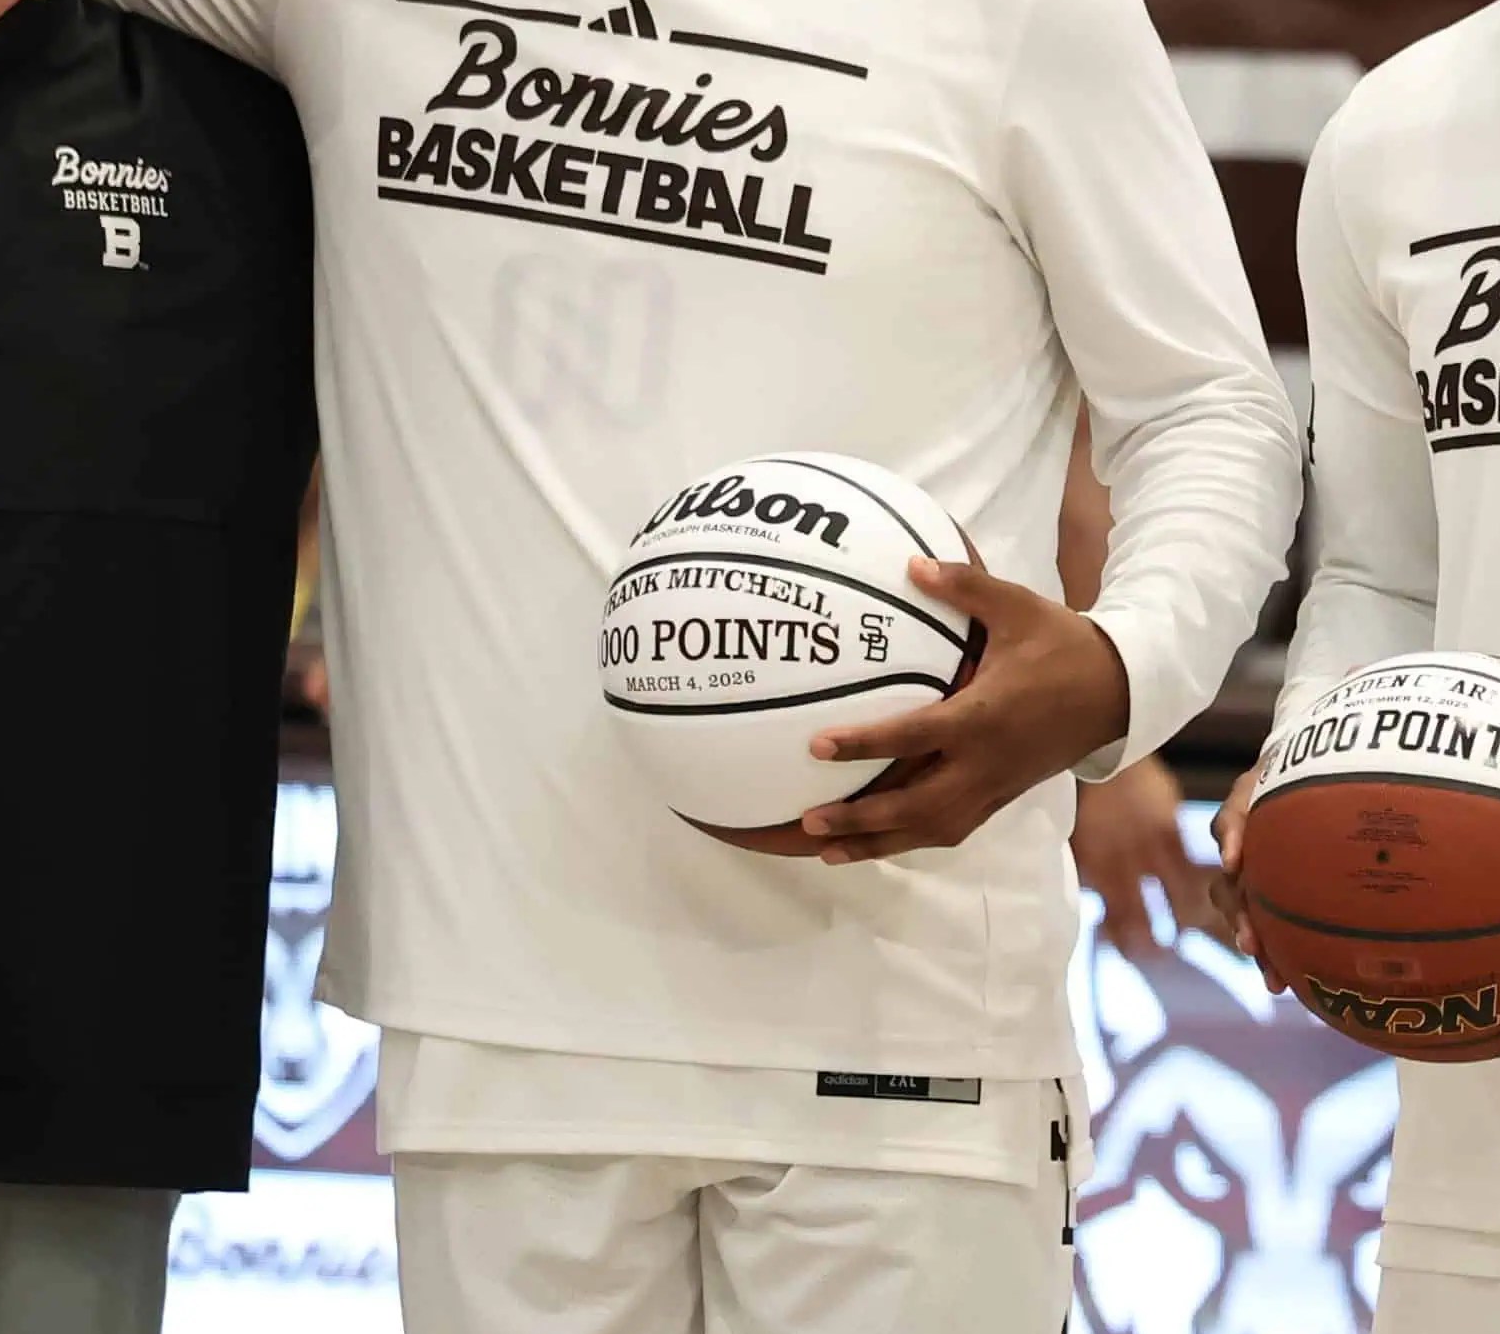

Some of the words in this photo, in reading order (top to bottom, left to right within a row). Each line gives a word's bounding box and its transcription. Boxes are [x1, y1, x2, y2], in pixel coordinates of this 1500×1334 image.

[425, 19, 788, 163] Bonnies
[52, 145, 167, 193] Bonnies
[377, 117, 832, 254] BASKETBALL
[63, 189, 169, 217] BASKETBALL
[100, 215, 141, 269] B
[702, 523, 781, 544] BASKETBALL
[602, 571, 663, 623] RANK
[667, 567, 832, 618] MITCHELL
[652, 618, 840, 665] POINTS
[626, 676, 680, 692] MARCH
[686, 675, 702, 691] 4,
[708, 670, 756, 688] 2026
[1279, 712, 1362, 773] 1000
